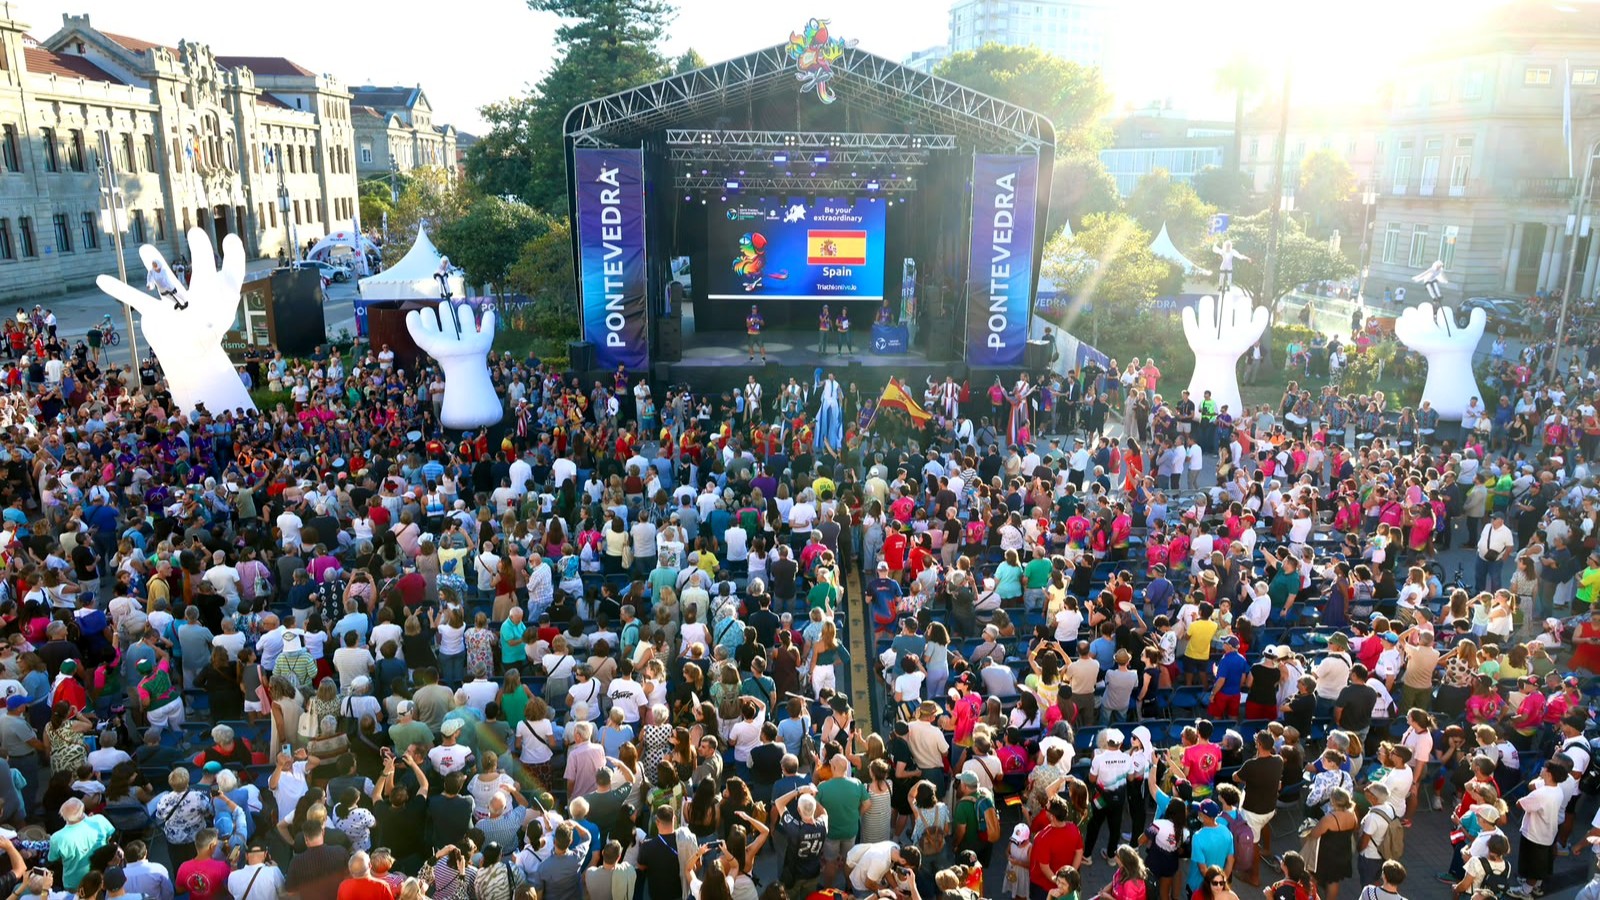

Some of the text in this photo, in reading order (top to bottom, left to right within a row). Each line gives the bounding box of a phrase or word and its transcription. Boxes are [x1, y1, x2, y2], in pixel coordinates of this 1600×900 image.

[813, 214, 863, 223] extraordinary
[824, 206, 853, 216] Be your
[600, 167, 626, 347] PONTEVEDRA
[988, 172, 1016, 349] PONTEVEDRA
[822, 266, 852, 278] Spain
[798, 839, 823, 857] 24
